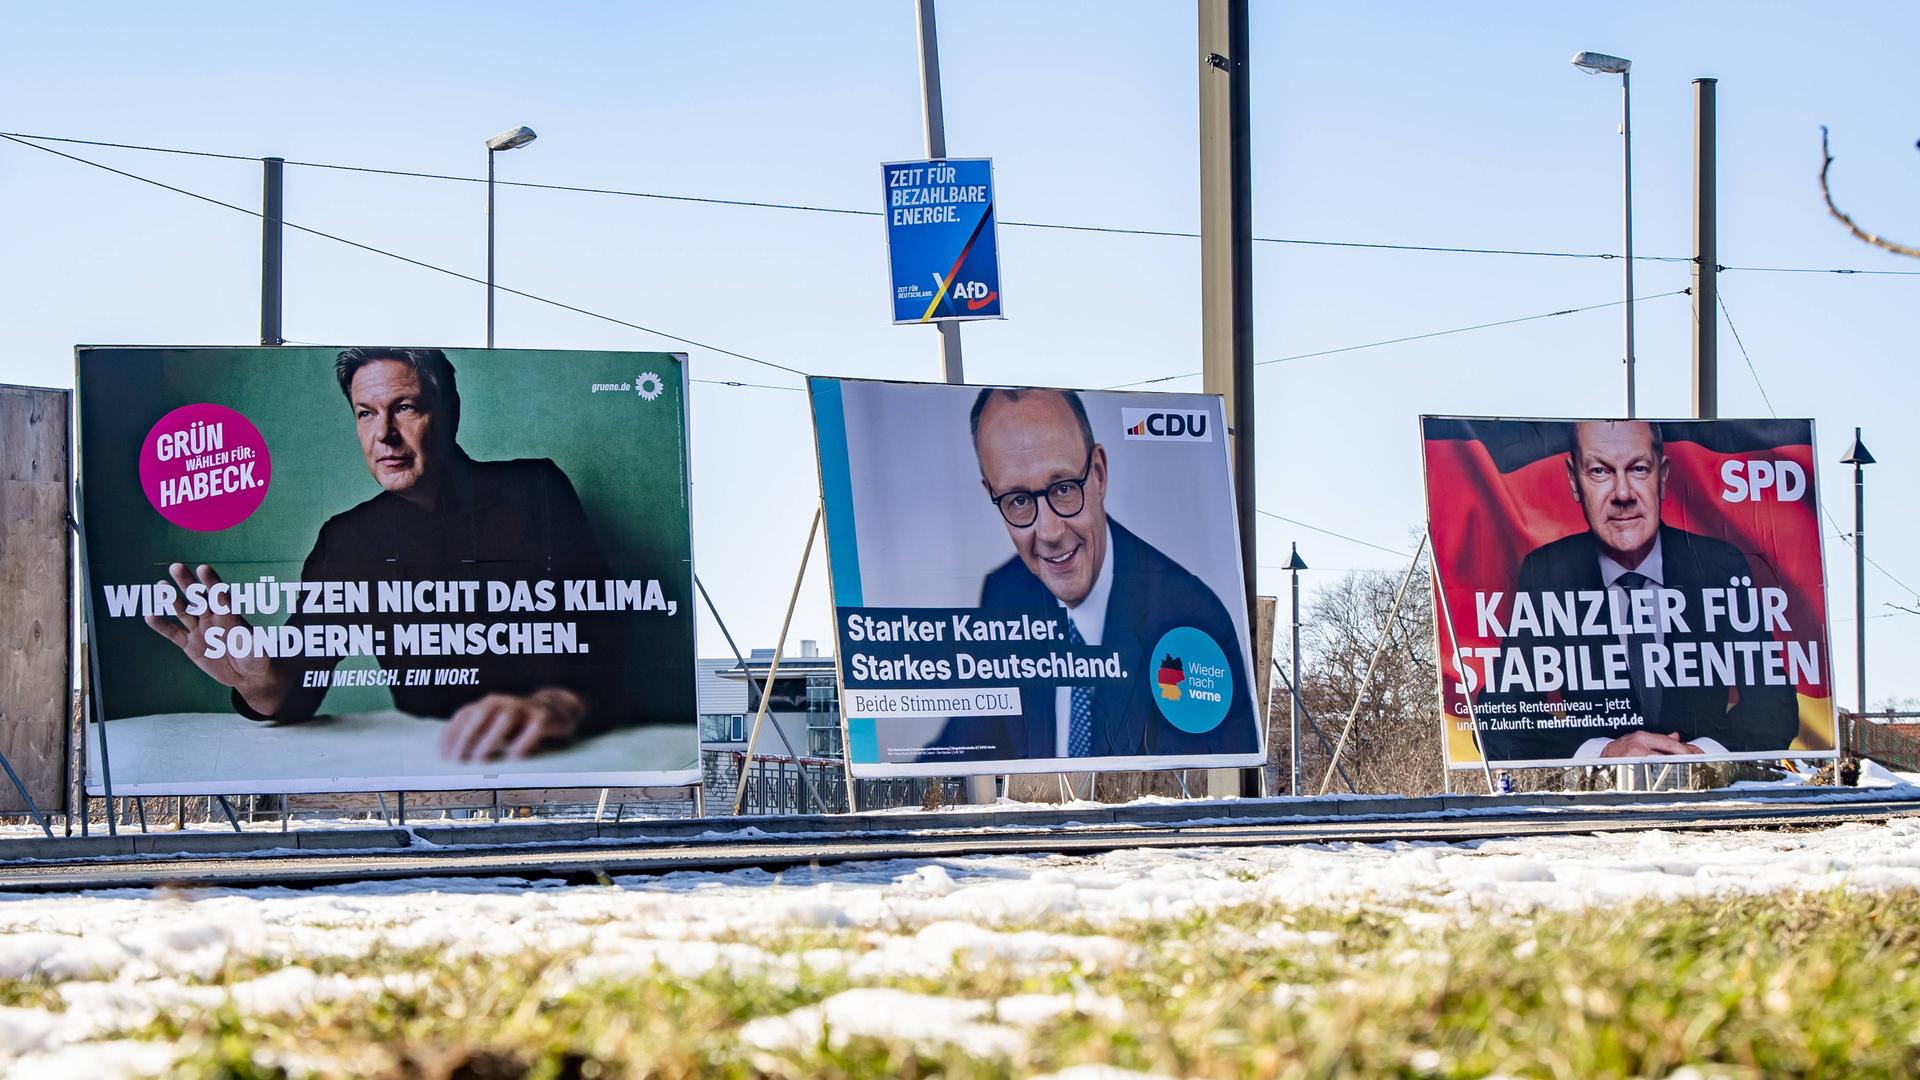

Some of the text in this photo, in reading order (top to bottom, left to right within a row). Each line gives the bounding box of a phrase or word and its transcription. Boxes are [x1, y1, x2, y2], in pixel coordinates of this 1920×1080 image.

[890, 163, 956, 188] ZEIT FÜR
[892, 185, 987, 207] BEZAHLBARE
[893, 206, 960, 226] ENERGIE.
[953, 280, 988, 299] AfD
[591, 382, 631, 393] gruene.de
[1146, 413, 1206, 438] CDU
[156, 420, 224, 462] GRÜN
[185, 445, 256, 472] WÄHLEN FÜR:
[160, 461, 264, 508] HABECK.
[1720, 459, 1807, 503] SPD
[103, 575, 678, 618] WIR SCHÜTZEN NICHT DAS KLIMA,
[1475, 575, 1793, 638] KANZLER FÜR
[847, 613, 1065, 642] Starker Kanzler.
[203, 622, 589, 660] SONDERN: MENSCHEN.
[302, 667, 480, 688] EIN MENSCH. EIN WORT.
[851, 652, 1128, 681] Starkes Deutschland.
[1188, 661, 1225, 678] Wieder
[1452, 640, 1821, 695] STABILE RENTEN
[1188, 676, 1214, 689] nach
[1189, 688, 1222, 702] vorne
[855, 693, 1013, 712] Beide Stimmen CDU.
[1454, 701, 1517, 715] Gaantiertes
[1520, 699, 1592, 713] Rentenniveau
[1604, 697, 1631, 713] jetzt
[1478, 718, 1488, 730] in
[1490, 716, 1535, 731] Zukunft:
[1536, 714, 1644, 730] mehrfürdich.spd.de
